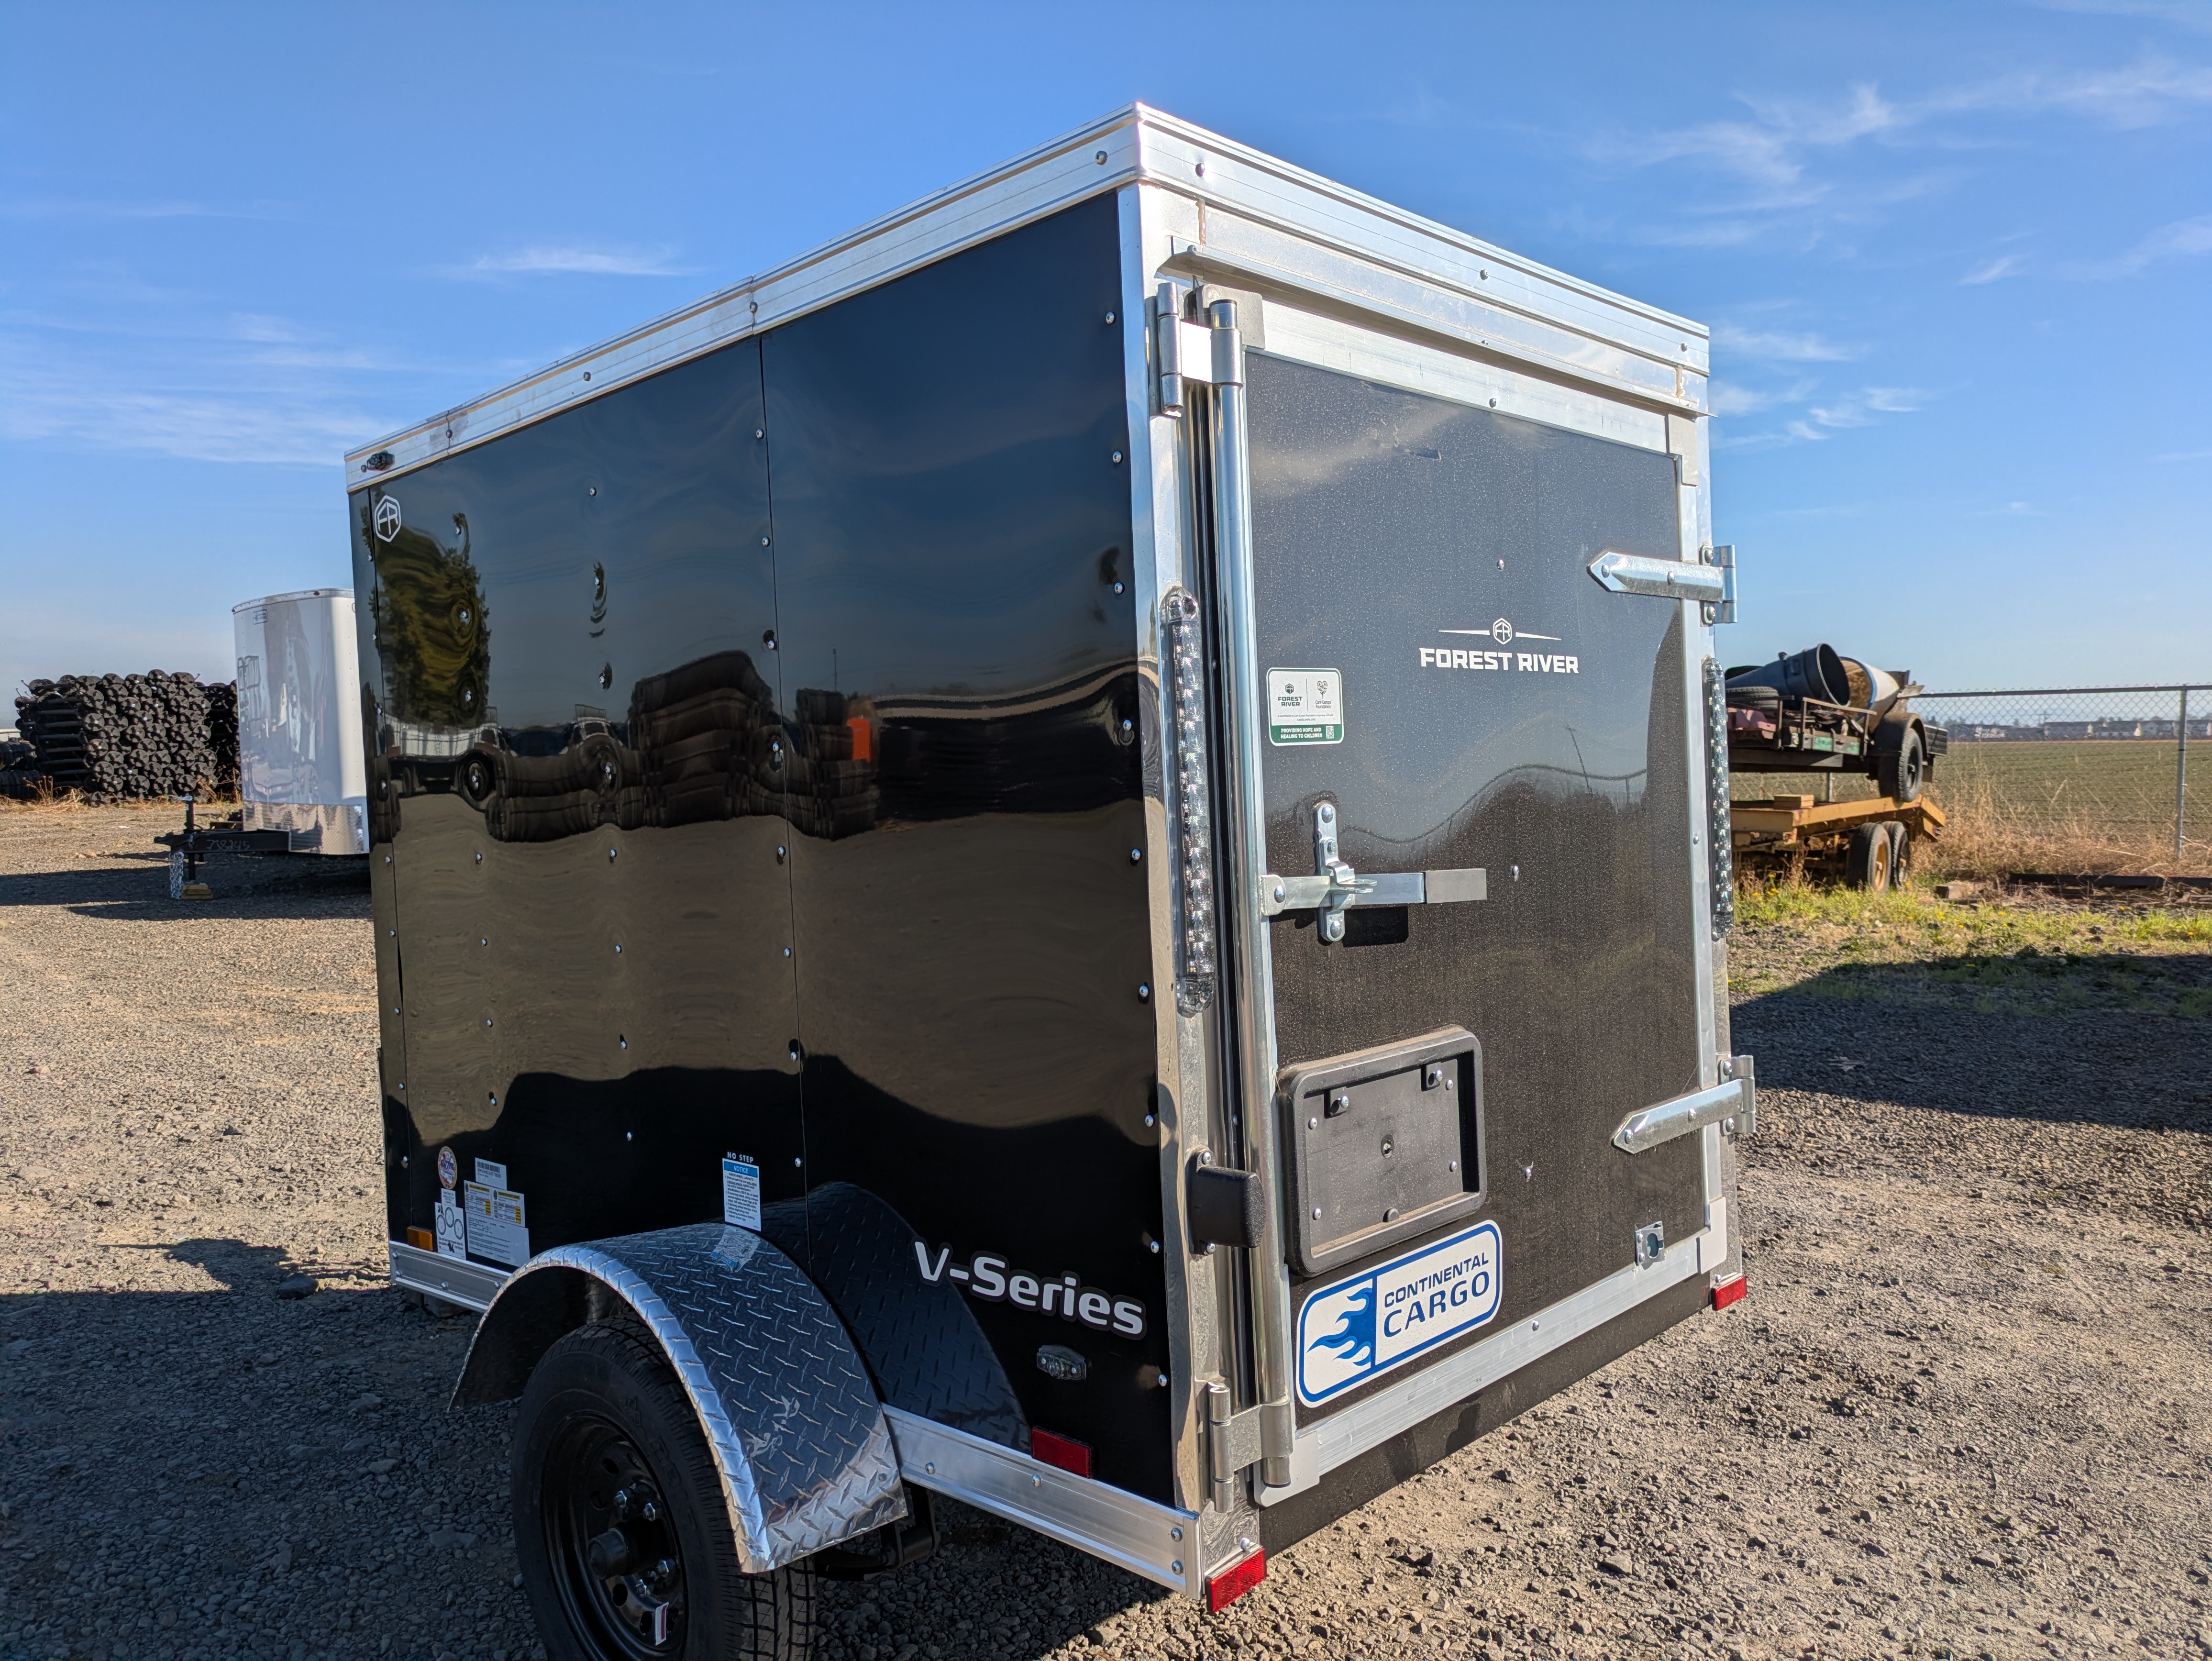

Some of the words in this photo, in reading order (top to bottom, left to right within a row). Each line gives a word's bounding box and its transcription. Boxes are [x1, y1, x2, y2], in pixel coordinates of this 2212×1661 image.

[1419, 648, 1513, 671] FOREST
[1516, 653, 1579, 674] RIVER
[727, 1151, 737, 1160] NO
[739, 1154, 753, 1163] STEP
[733, 1165, 749, 1174] NOTICE
[915, 1241, 1143, 1334] V-Series
[1384, 1252, 1489, 1308] CONTINENTAL
[1383, 1271, 1490, 1338] CARGO
